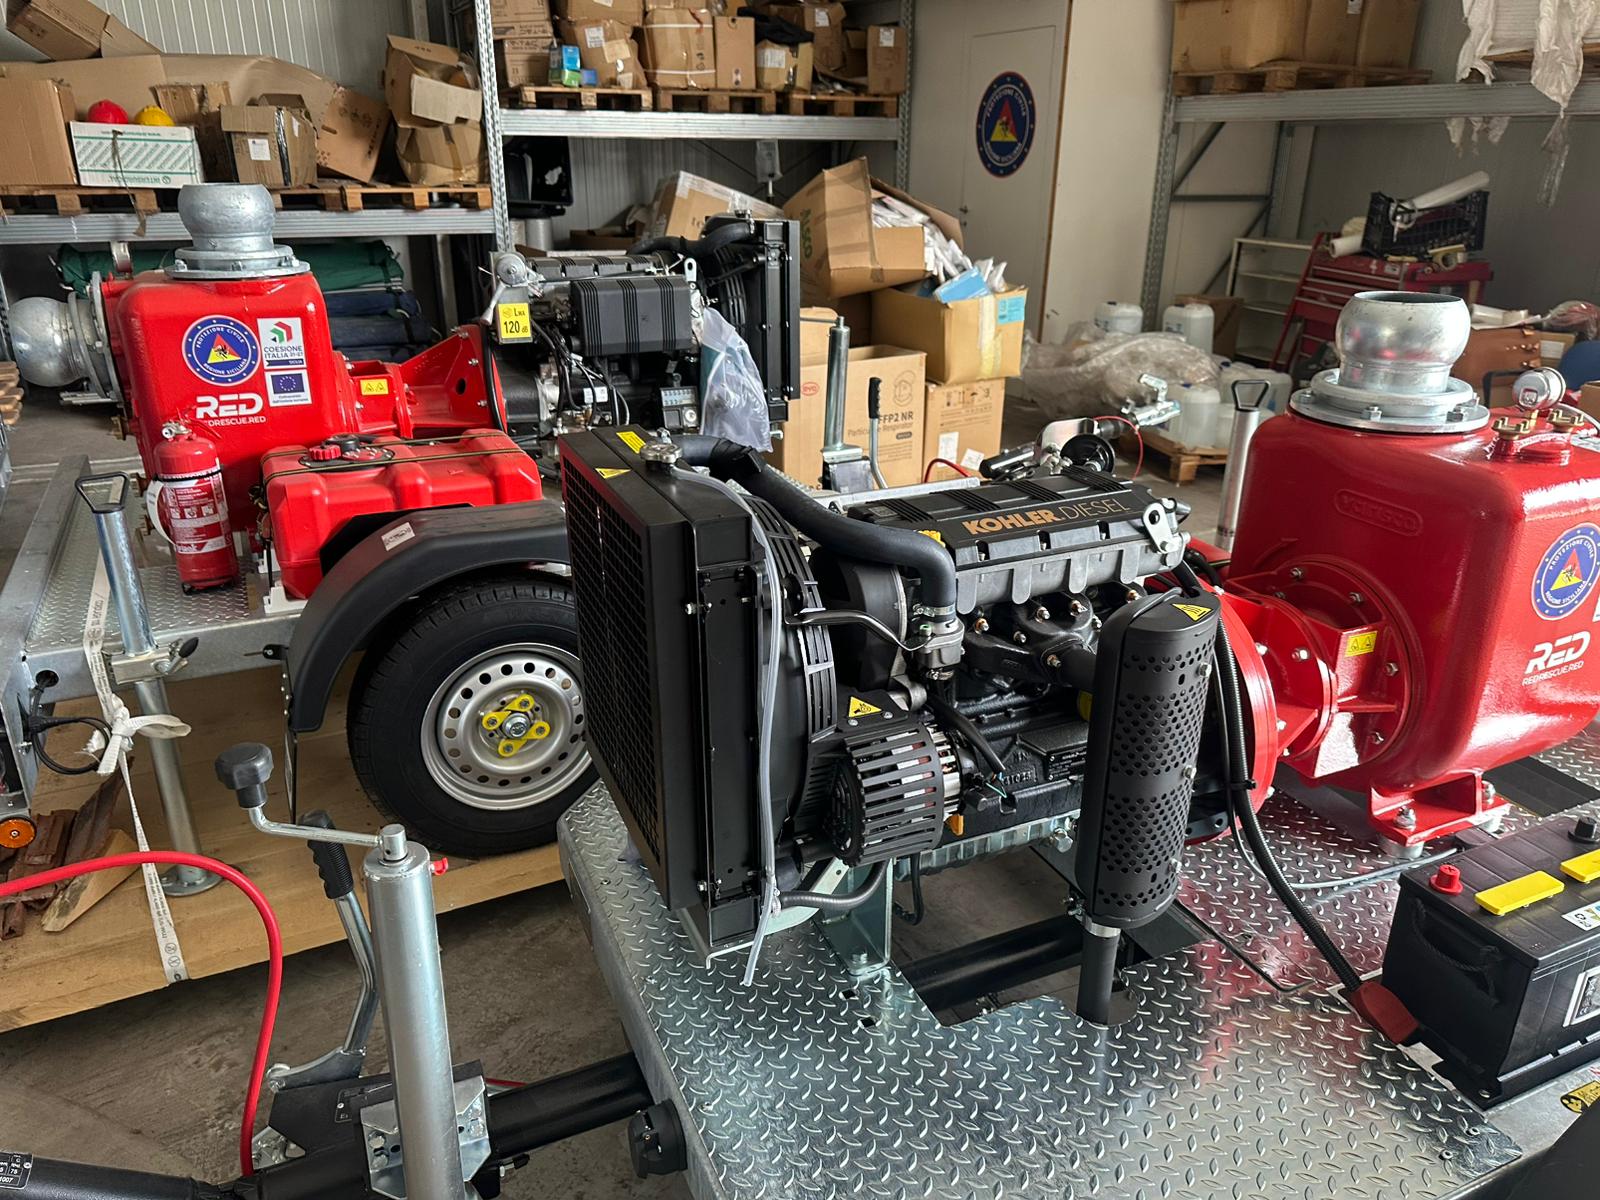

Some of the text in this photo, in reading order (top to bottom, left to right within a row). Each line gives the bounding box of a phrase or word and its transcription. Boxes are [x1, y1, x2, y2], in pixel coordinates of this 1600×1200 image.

[196, 326, 246, 348] PROTEZIONE CIVILE
[504, 320, 520, 334] 120
[264, 345, 302, 353] COESIONE
[203, 358, 248, 375] REGIONE SICILIANA
[196, 392, 263, 419] RED
[901, 410, 915, 421] NR
[961, 498, 1131, 535] KOHLER DIESEL
[1548, 538, 1595, 570] PROTEZIONE CIVILE
[1545, 580, 1588, 605] REGIONE SICILIANA
[1524, 630, 1591, 675] RED
